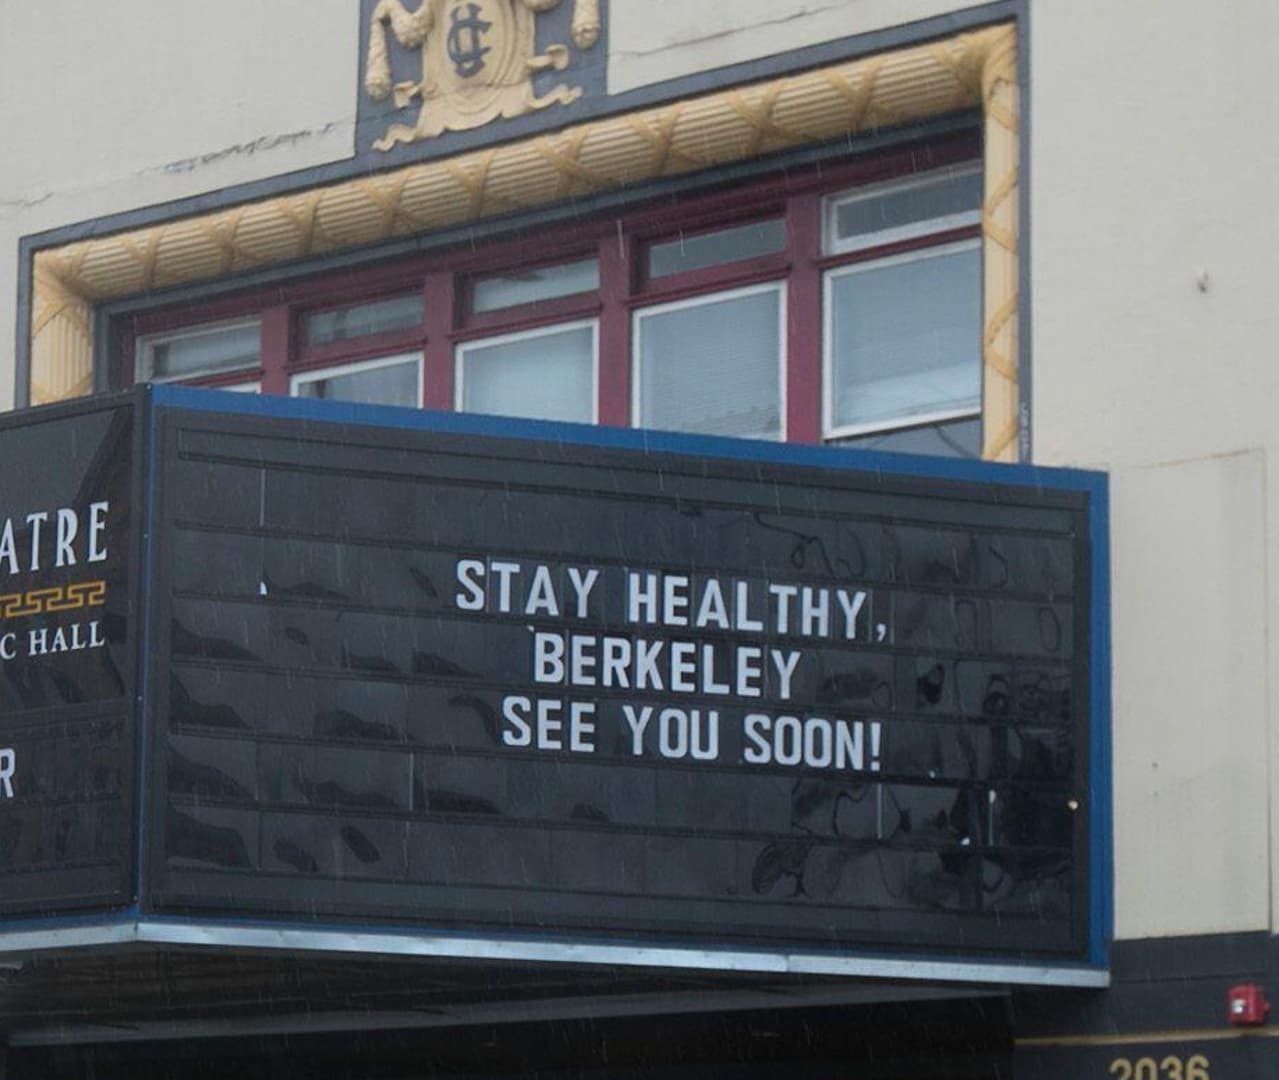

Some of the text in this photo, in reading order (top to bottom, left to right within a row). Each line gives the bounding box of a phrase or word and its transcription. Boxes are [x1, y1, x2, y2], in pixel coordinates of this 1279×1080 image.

[456, 559, 887, 642] STAY HEALTHY,
[28, 621, 106, 656] HALL
[534, 631, 801, 699] BERKELEY
[502, 696, 883, 772] SEE YOU SOON!
